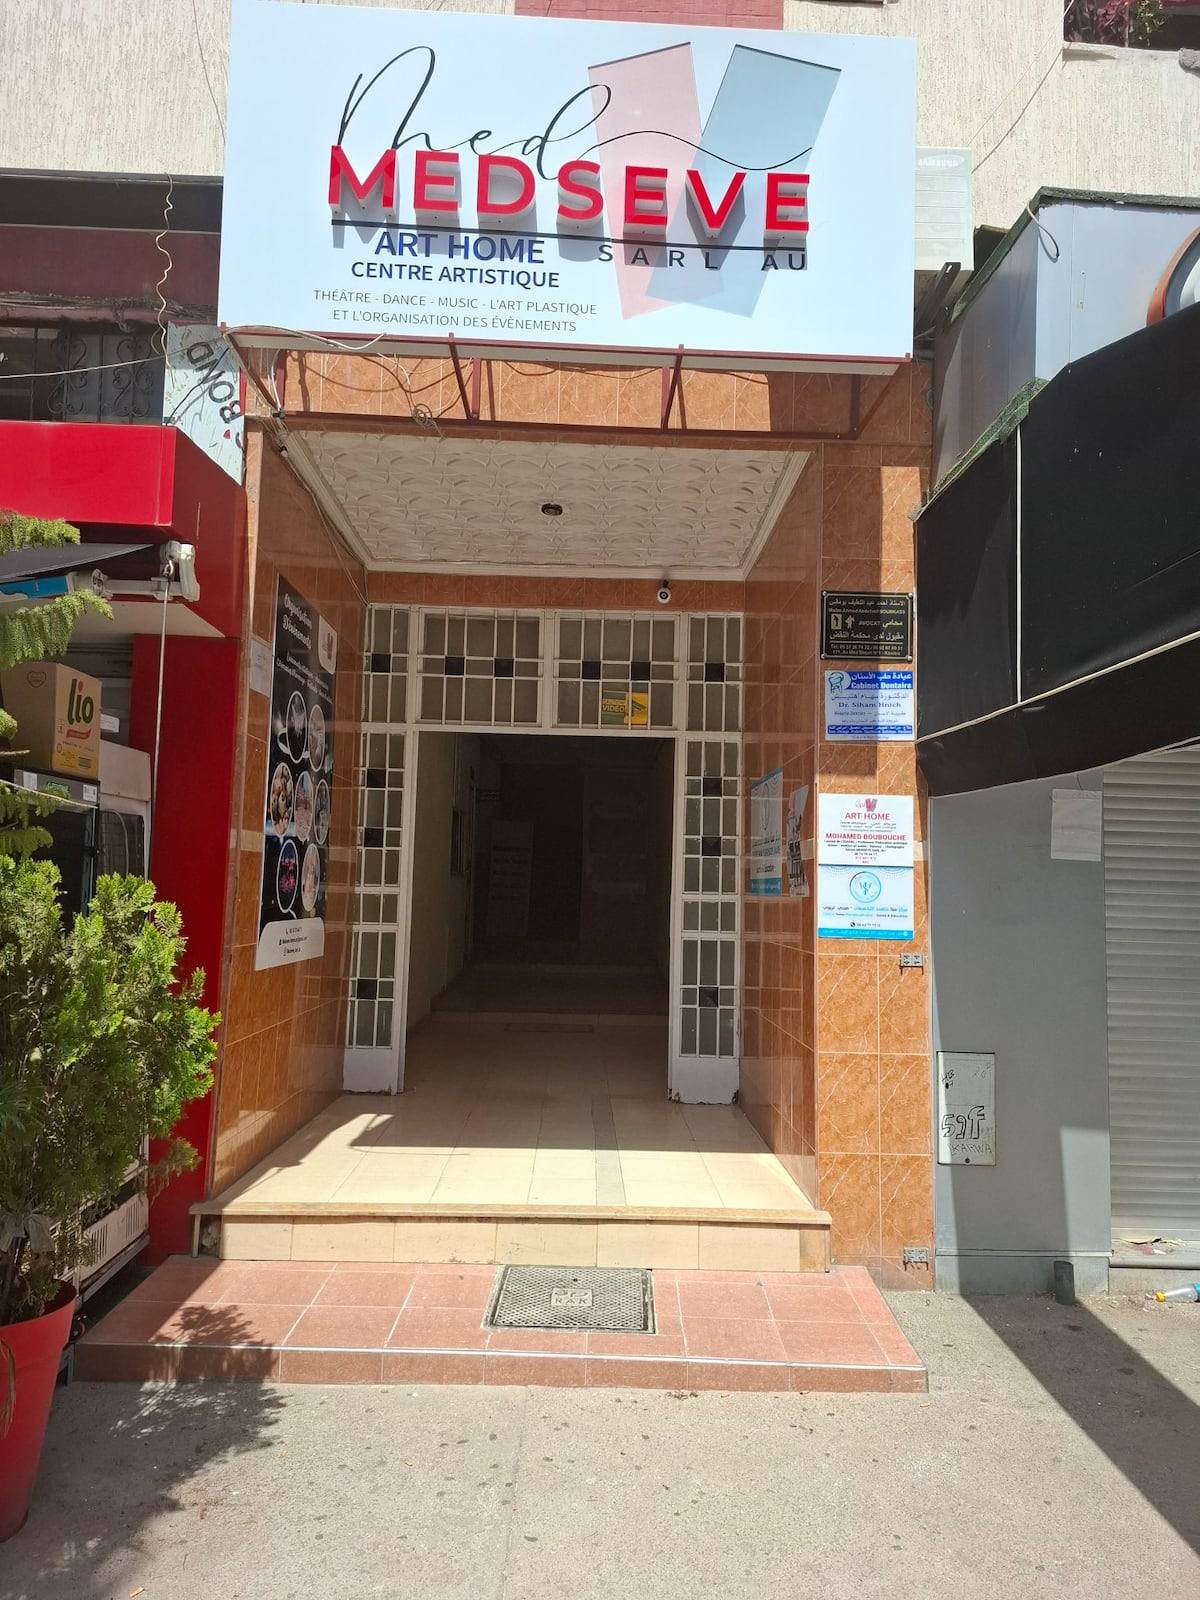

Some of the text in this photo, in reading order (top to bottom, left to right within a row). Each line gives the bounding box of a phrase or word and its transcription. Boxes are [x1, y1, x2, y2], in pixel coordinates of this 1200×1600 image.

[327, 144, 810, 232] MEDSEVE
[374, 231, 545, 264] ART HOME
[761, 253, 806, 271] AU
[351, 261, 560, 289] CENTRE ARTISTIQUE
[313, 288, 372, 304] THÉÂTRE
[382, 293, 426, 307] DANCE
[438, 296, 478, 309] MUSIC
[490, 299, 522, 311] L'ART
[527, 301, 598, 315] PLASTIQUE
[333, 310, 577, 332] ET L'ORGANISATION DES ÉVÈNEMENTS
[851, 671, 912, 681] عيادة طب الأسنان
[880, 682, 912, 690] Dentaire
[67, 678, 94, 726] lio
[845, 812, 891, 821] ART HOME
[825, 832, 907, 841] MOHAMED BOUBOUCHE
